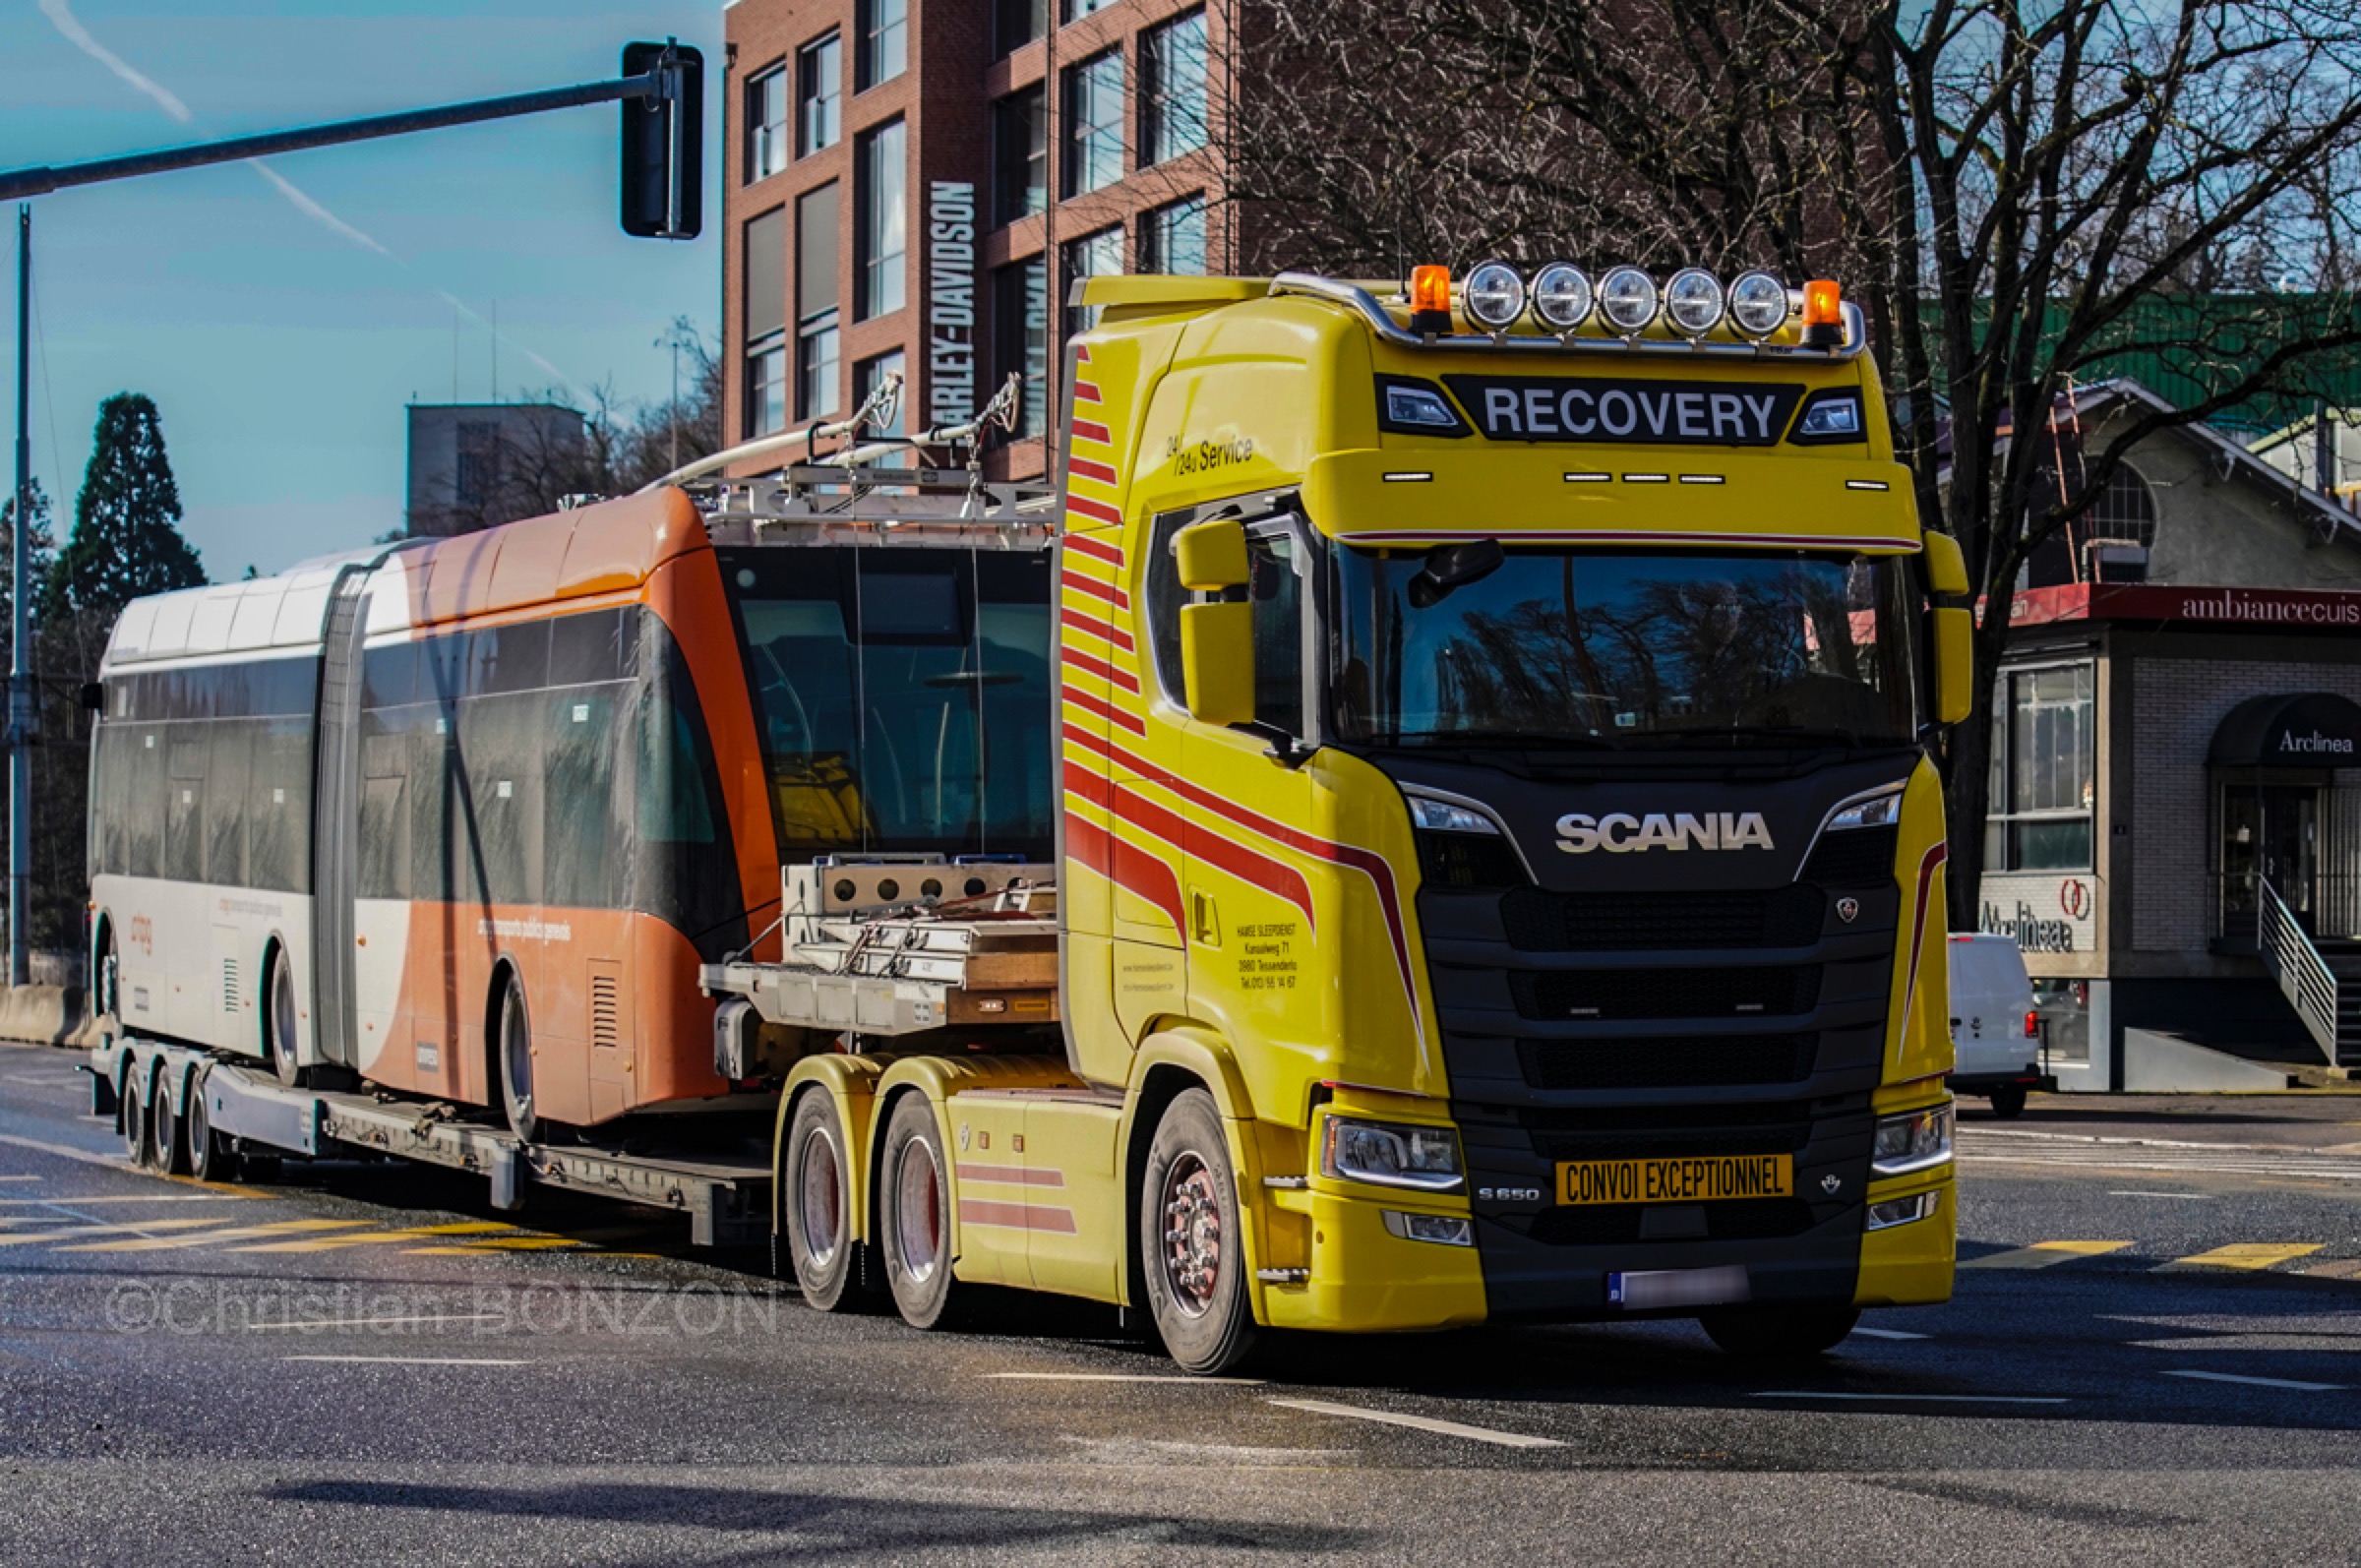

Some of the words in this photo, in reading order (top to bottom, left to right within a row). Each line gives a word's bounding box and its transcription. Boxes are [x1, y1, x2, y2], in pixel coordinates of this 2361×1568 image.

[1483, 387, 1777, 439] RECOVERY
[1199, 434, 1253, 471] Service
[2278, 728, 2354, 754] Arclinea
[1554, 812, 1776, 854] SCANIA
[1479, 1187, 1494, 1201] S
[1496, 1187, 1541, 1201] 650
[1566, 1161, 1639, 1202] CONVOI
[1646, 1156, 1785, 1199] EXCEPTIONNEL
